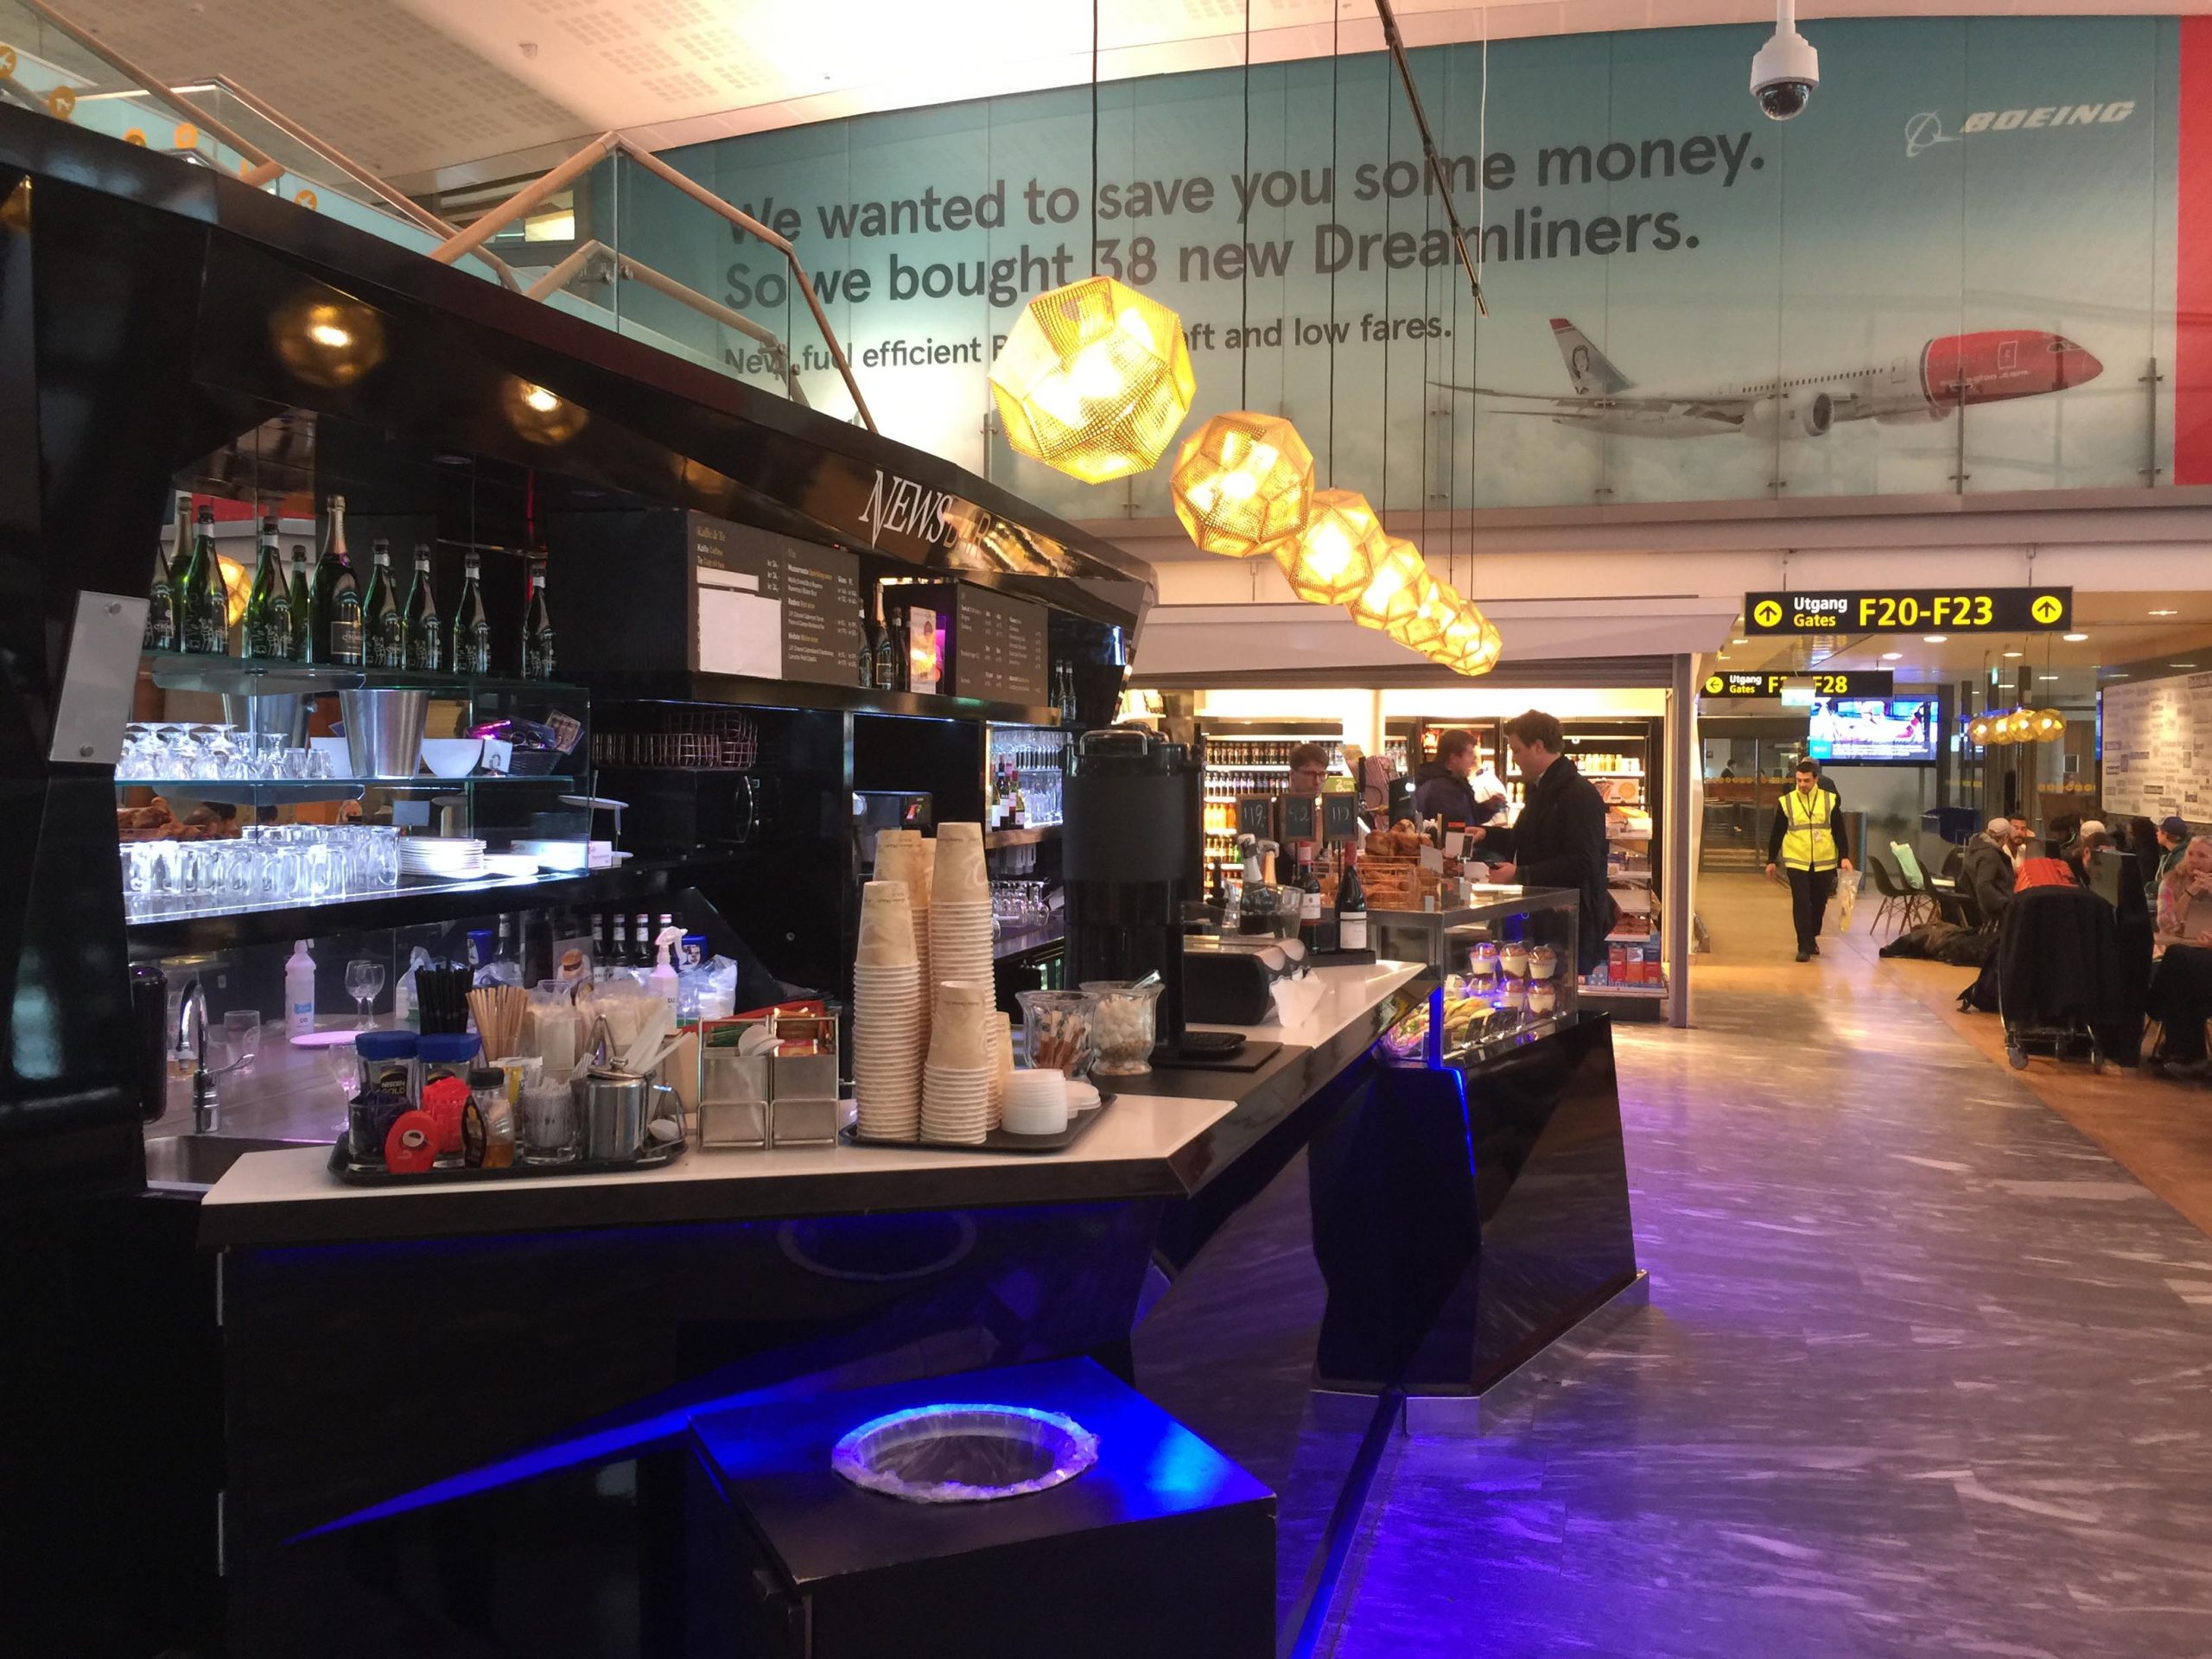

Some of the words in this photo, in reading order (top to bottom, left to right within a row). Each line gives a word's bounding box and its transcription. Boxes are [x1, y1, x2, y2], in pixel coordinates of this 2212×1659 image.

[1961, 100, 2135, 133] BOEING
[725, 196, 802, 245] We
[817, 179, 1006, 239] wanted
[1024, 177, 1080, 225] to
[1097, 176, 1213, 220] save
[1231, 168, 1332, 224] you
[1353, 150, 1516, 201] some
[1536, 131, 1765, 188] money.
[725, 263, 787, 309] So
[812, 269, 872, 304] we
[889, 243, 1073, 308] bought
[1095, 237, 1157, 285] 38
[1179, 239, 1294, 283] new
[1314, 207, 1700, 275] Dreamliners.
[1224, 317, 1283, 350] and
[1295, 318, 1356, 346] low
[1360, 313, 1452, 343] fares.
[862, 338, 982, 368] efficient
[1794, 597, 1848, 613] Utgang
[1794, 613, 1837, 626] Gates
[1859, 596, 1993, 626] F20-F23
[1729, 675, 1763, 685] Utgang
[1729, 684, 1756, 694] Gates
